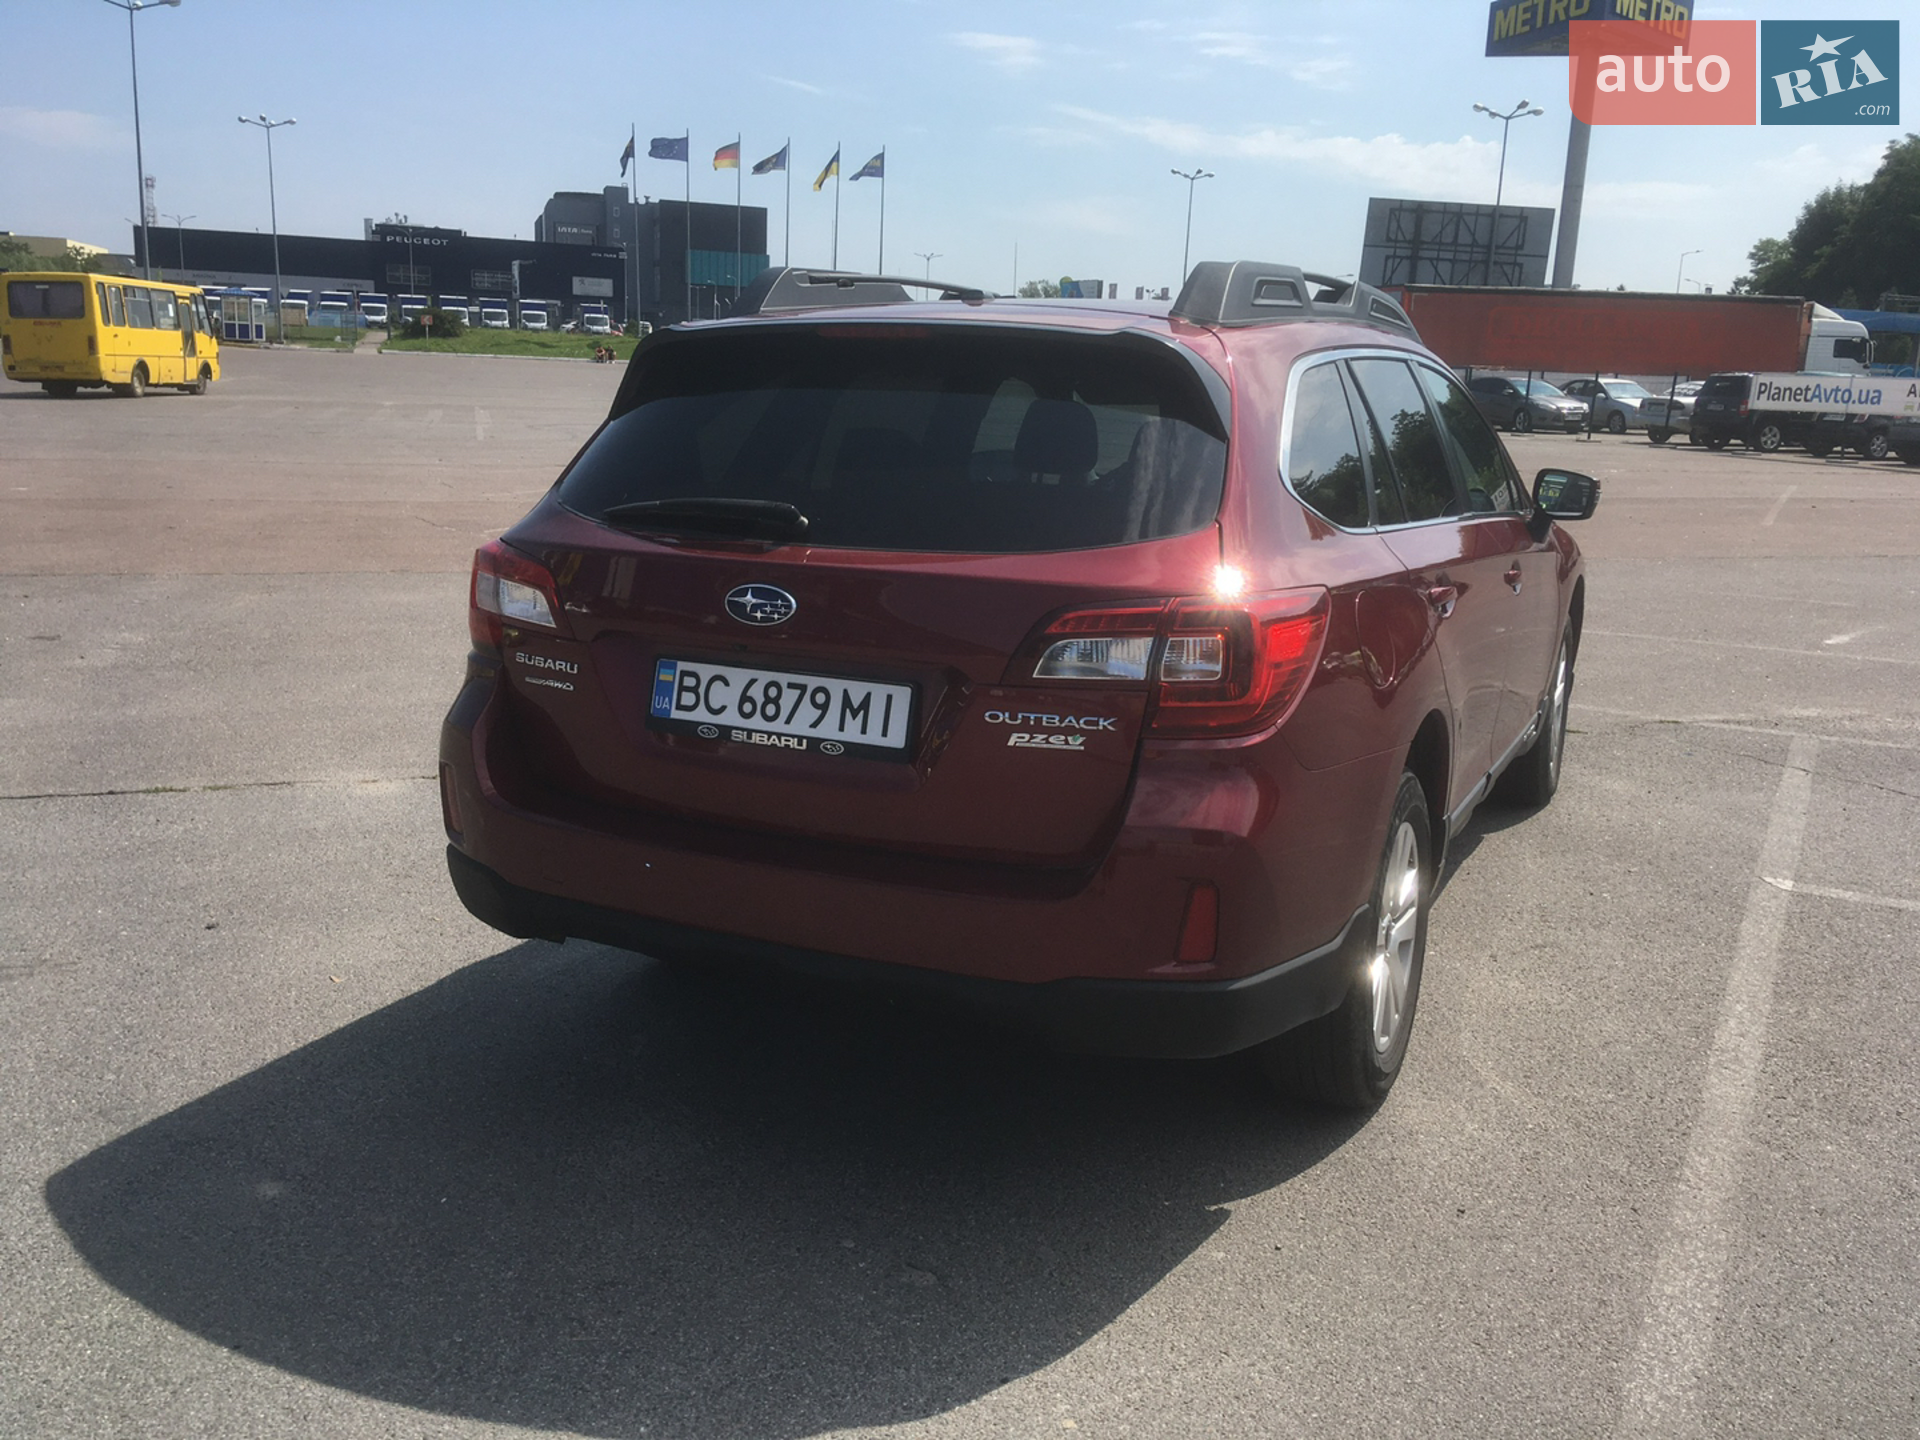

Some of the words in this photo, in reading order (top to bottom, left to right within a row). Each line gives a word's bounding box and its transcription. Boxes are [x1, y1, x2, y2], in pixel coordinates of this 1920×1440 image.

[1493, 0, 1591, 42] METRO
[386, 234, 449, 247] PEUGEOT
[1756, 381, 1883, 406] PlanetAvto.ua
[515, 651, 579, 675] SUBARU
[654, 696, 671, 711] UA
[983, 710, 1119, 732] OUTBACK
[731, 729, 807, 750] SUBARU
